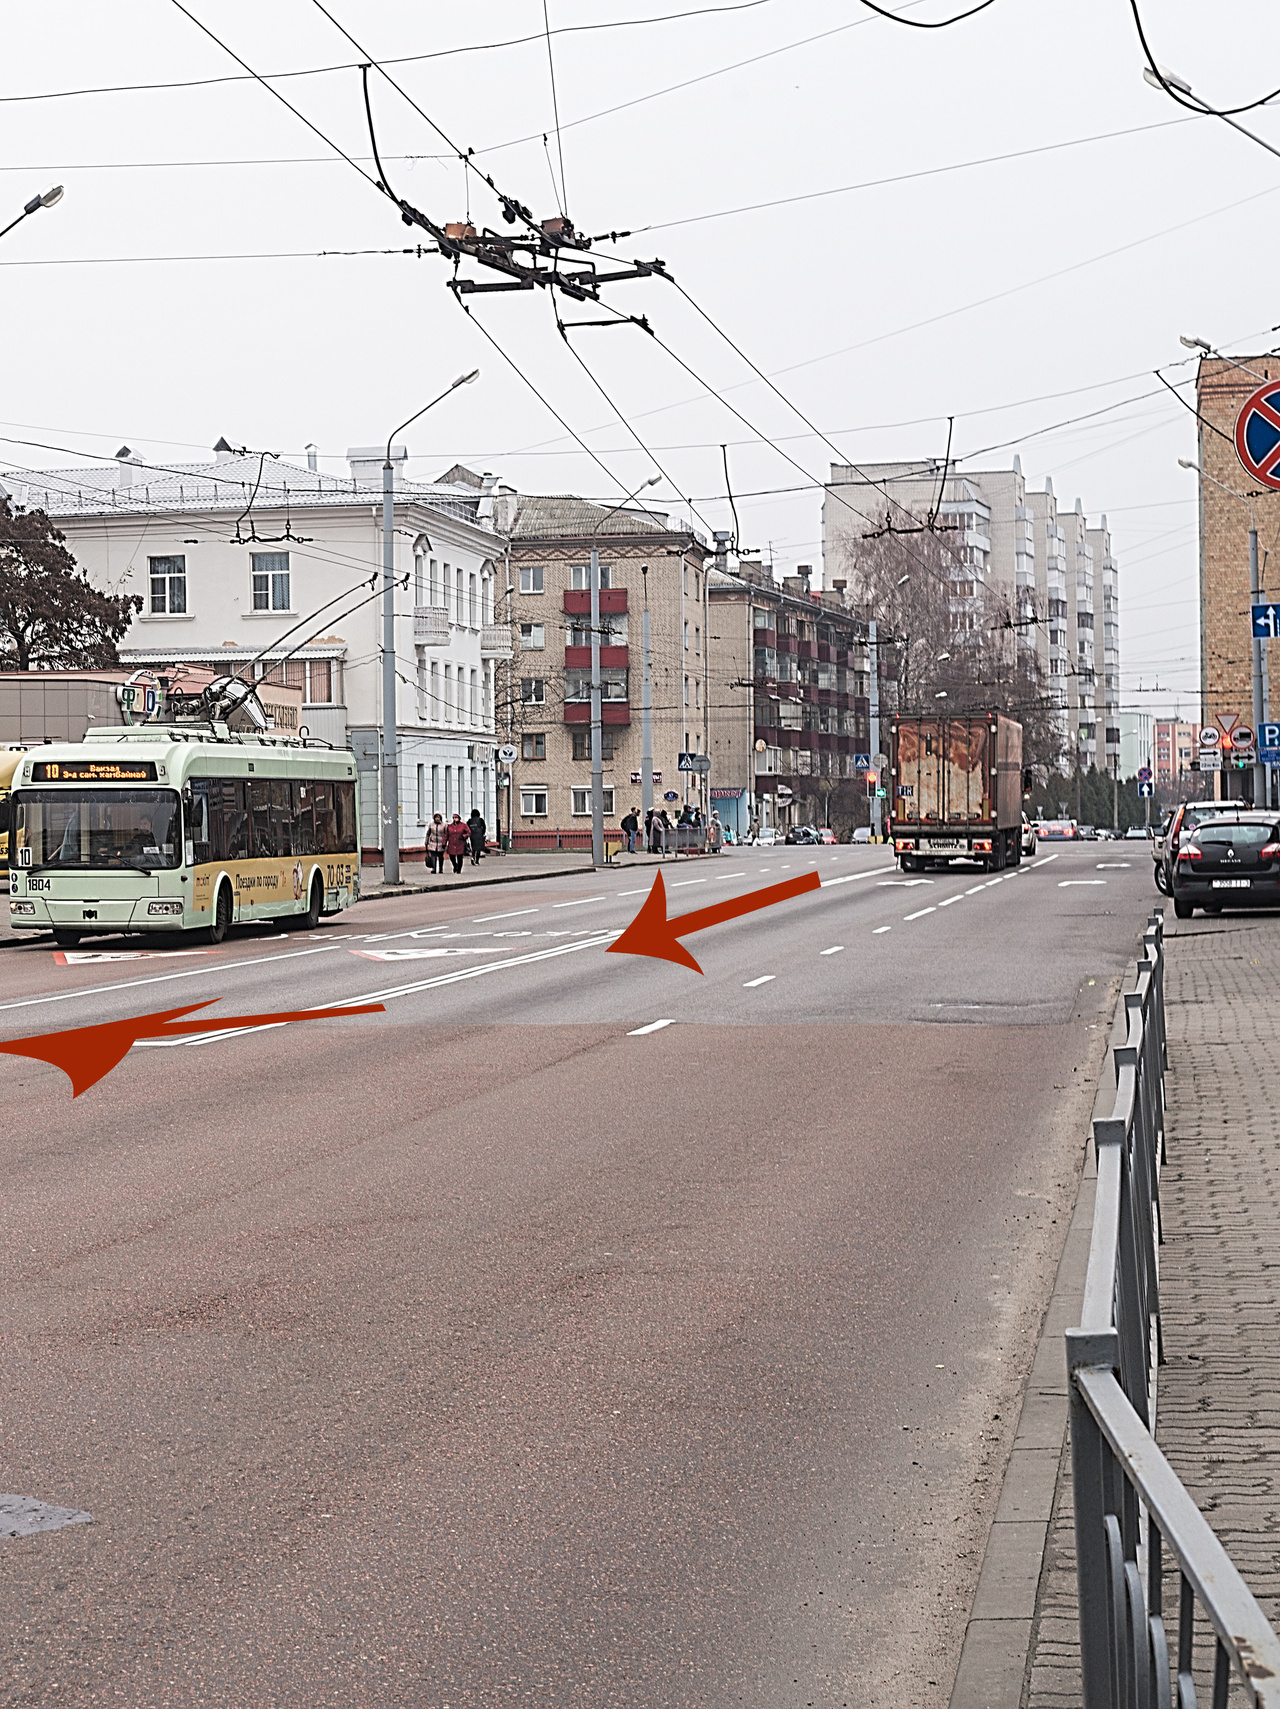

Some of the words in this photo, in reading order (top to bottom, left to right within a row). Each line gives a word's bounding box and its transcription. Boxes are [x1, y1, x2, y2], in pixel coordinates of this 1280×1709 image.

[121, 682, 157, 712] ФОТО
[46, 764, 59, 779] 10
[898, 786, 913, 797] TIR
[20, 849, 30, 865] 10
[28, 879, 51, 891] 1804
[236, 874, 256, 891] Поездки
[263, 874, 279, 889] городу
